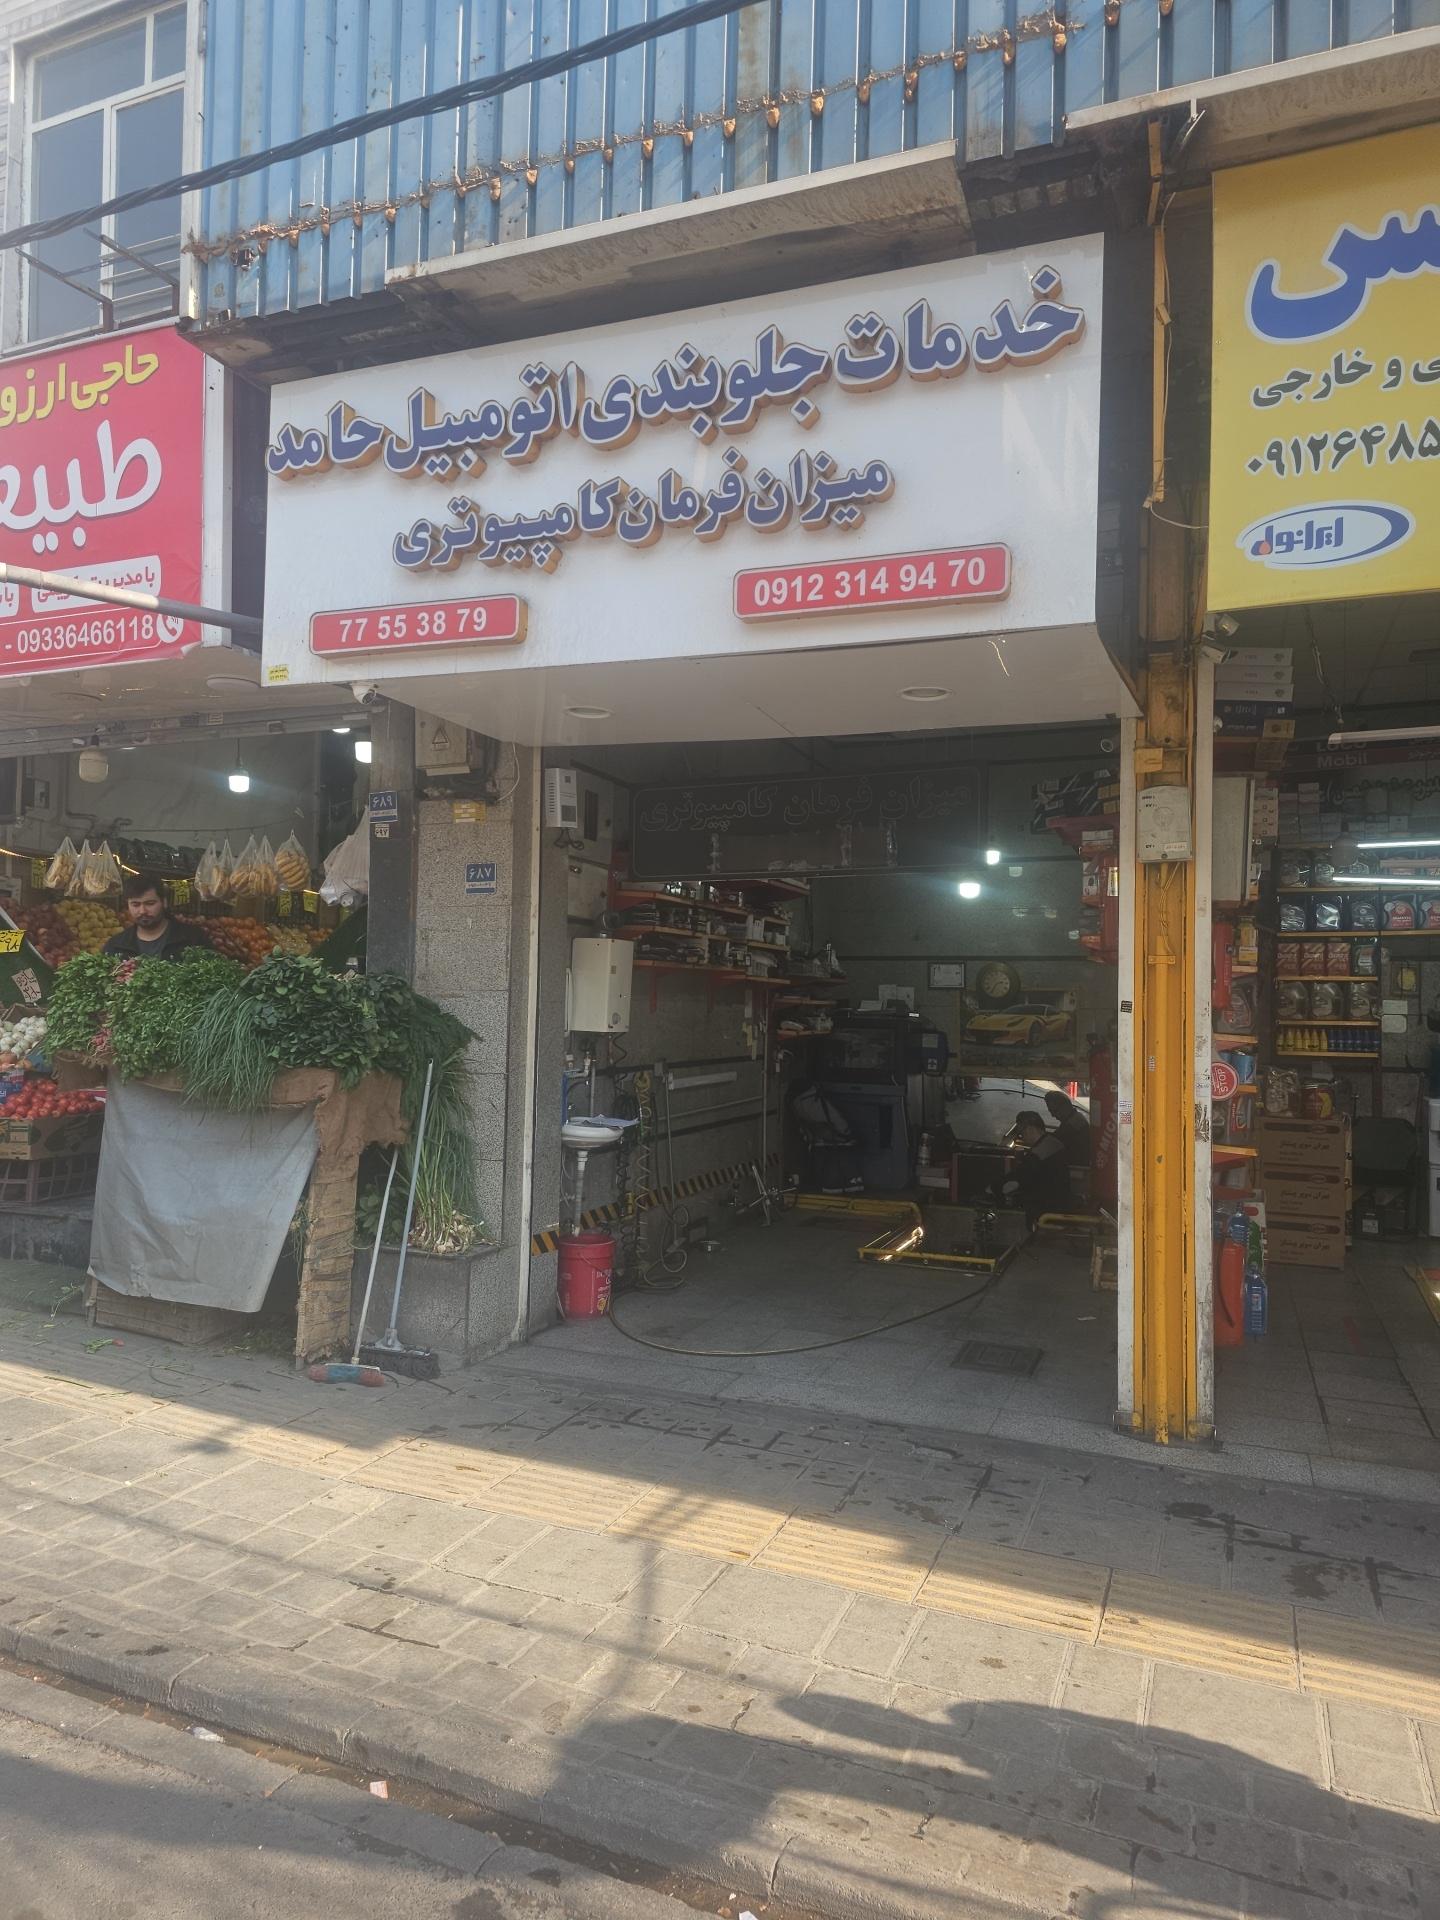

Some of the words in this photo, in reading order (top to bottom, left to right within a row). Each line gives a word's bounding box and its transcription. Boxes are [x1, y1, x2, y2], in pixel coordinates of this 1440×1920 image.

[834, 265, 1086, 390] خدمات
[0, 362, 66, 427] ارزو
[71, 345, 158, 409] حاجی
[581, 324, 831, 445] جلوبندی
[1253, 350, 1372, 407] خارجی
[1382, 358, 1401, 389] و
[266, 400, 384, 479] حامد
[384, 361, 582, 477] اتومبیل
[1247, 419, 1440, 476] ۰۹۱۲۶۴۸۵
[0, 420, 161, 553] طبیع
[618, 446, 746, 546] فرمان
[746, 449, 894, 530] میزان
[393, 477, 628, 573] کامپیوتری
[754, 574, 823, 608] 0912
[835, 567, 888, 598] 314
[900, 562, 936, 592] 94
[948, 556, 986, 587] 70
[17, 614, 153, 654] 09336466118
[339, 617, 366, 642] 77
[377, 614, 406, 639] 55
[416, 611, 446, 636] 38
[457, 607, 487, 632] 79
[1317, 751, 1368, 769] Mobil
[469, 867, 492, 880] ۶۸۷
